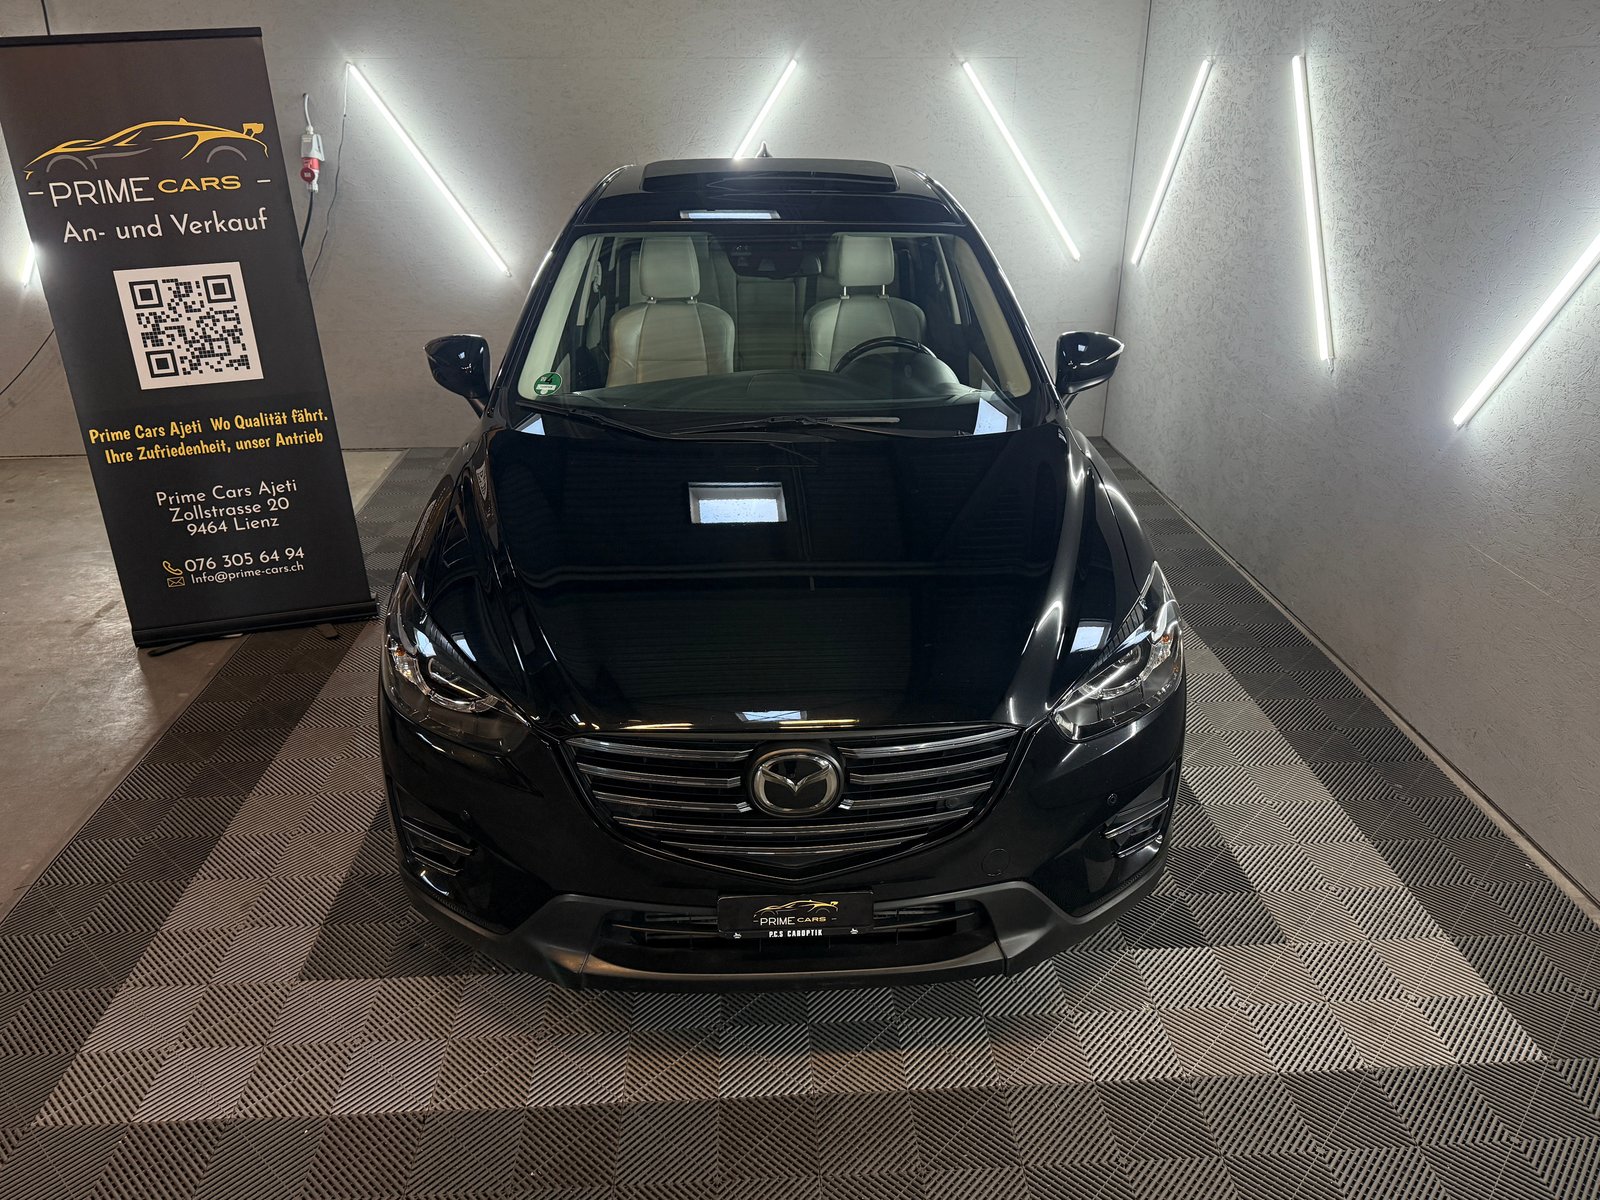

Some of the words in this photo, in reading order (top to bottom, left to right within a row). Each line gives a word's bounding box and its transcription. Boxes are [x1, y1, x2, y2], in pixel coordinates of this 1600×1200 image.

[48, 176, 155, 208] PRIME
[157, 175, 242, 194] CARS
[63, 220, 106, 244] An-
[115, 213, 163, 240] und
[169, 206, 268, 236] Verkauf
[88, 426, 132, 444] Prime
[134, 422, 166, 440] Cars
[169, 419, 203, 437] Ajeti
[209, 415, 231, 432] Wo
[234, 410, 288, 430] Qualität
[291, 407, 329, 424] fährt.
[104, 447, 134, 464] Ihre
[137, 438, 232, 462] Zufriedenheit,
[235, 435, 272, 451] unser
[275, 428, 325, 447] Antrieb
[155, 489, 207, 507] Prime
[211, 484, 252, 500] Cars
[258, 478, 298, 499] Ajeti
[169, 502, 263, 523] Zollstrasse
[266, 496, 290, 512] 20
[186, 520, 228, 536] 9464
[233, 515, 280, 532] Lienz
[184, 556, 217, 573] 076
[222, 551, 254, 569] 305
[258, 549, 281, 564] 64
[284, 545, 305, 561] 94
[190, 562, 305, 584] Info@prime-cars.ch
[760, 916, 795, 926] PRIME
